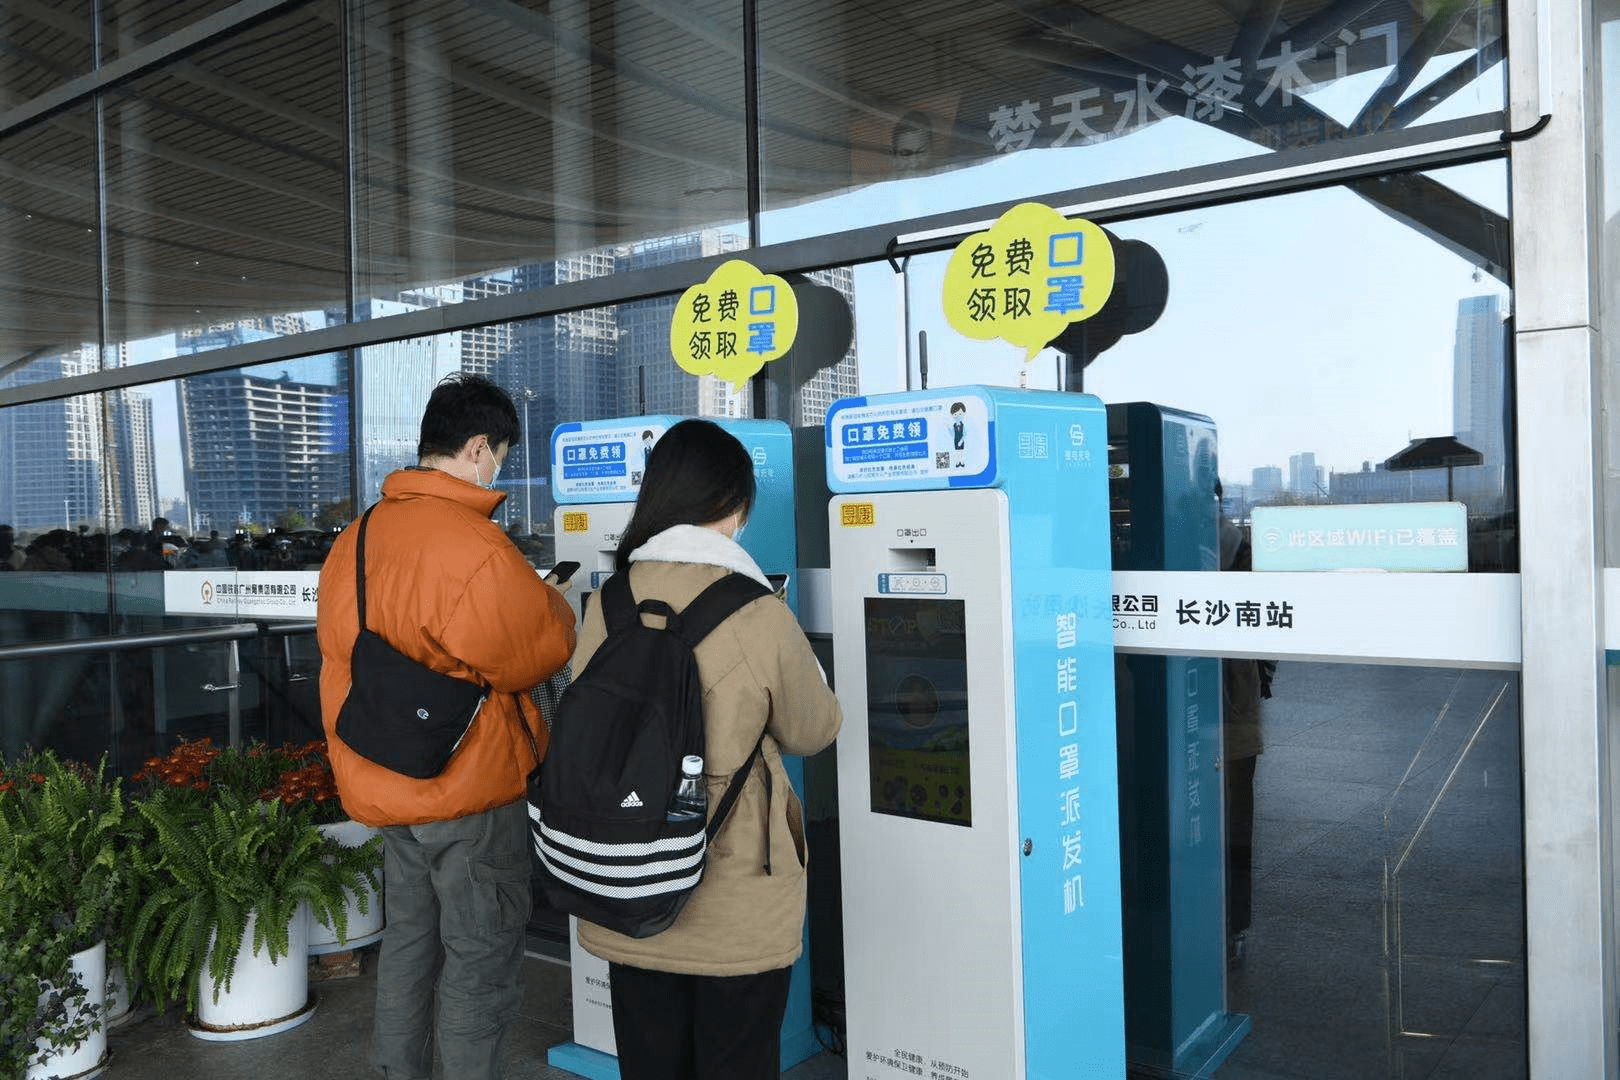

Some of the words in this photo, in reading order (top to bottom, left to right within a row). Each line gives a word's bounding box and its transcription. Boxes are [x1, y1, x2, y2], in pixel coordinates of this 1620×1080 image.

[988, 21, 1398, 152] 梦天水漆木门
[971, 238, 1034, 279] 免费
[1044, 231, 1084, 315] 口罩
[692, 289, 739, 323] 免费
[746, 285, 776, 356] 口罩
[967, 288, 1031, 321] 领取
[689, 331, 738, 360] 领取
[848, 421, 922, 443] 口罩免费领
[567, 445, 621, 461] 口罩免费领
[897, 529, 927, 537] 口罩出口
[1138, 619, 1156, 630] Ltd
[1176, 599, 1293, 628] 长沙南站
[1056, 612, 1084, 915] 智能口罩派发机
